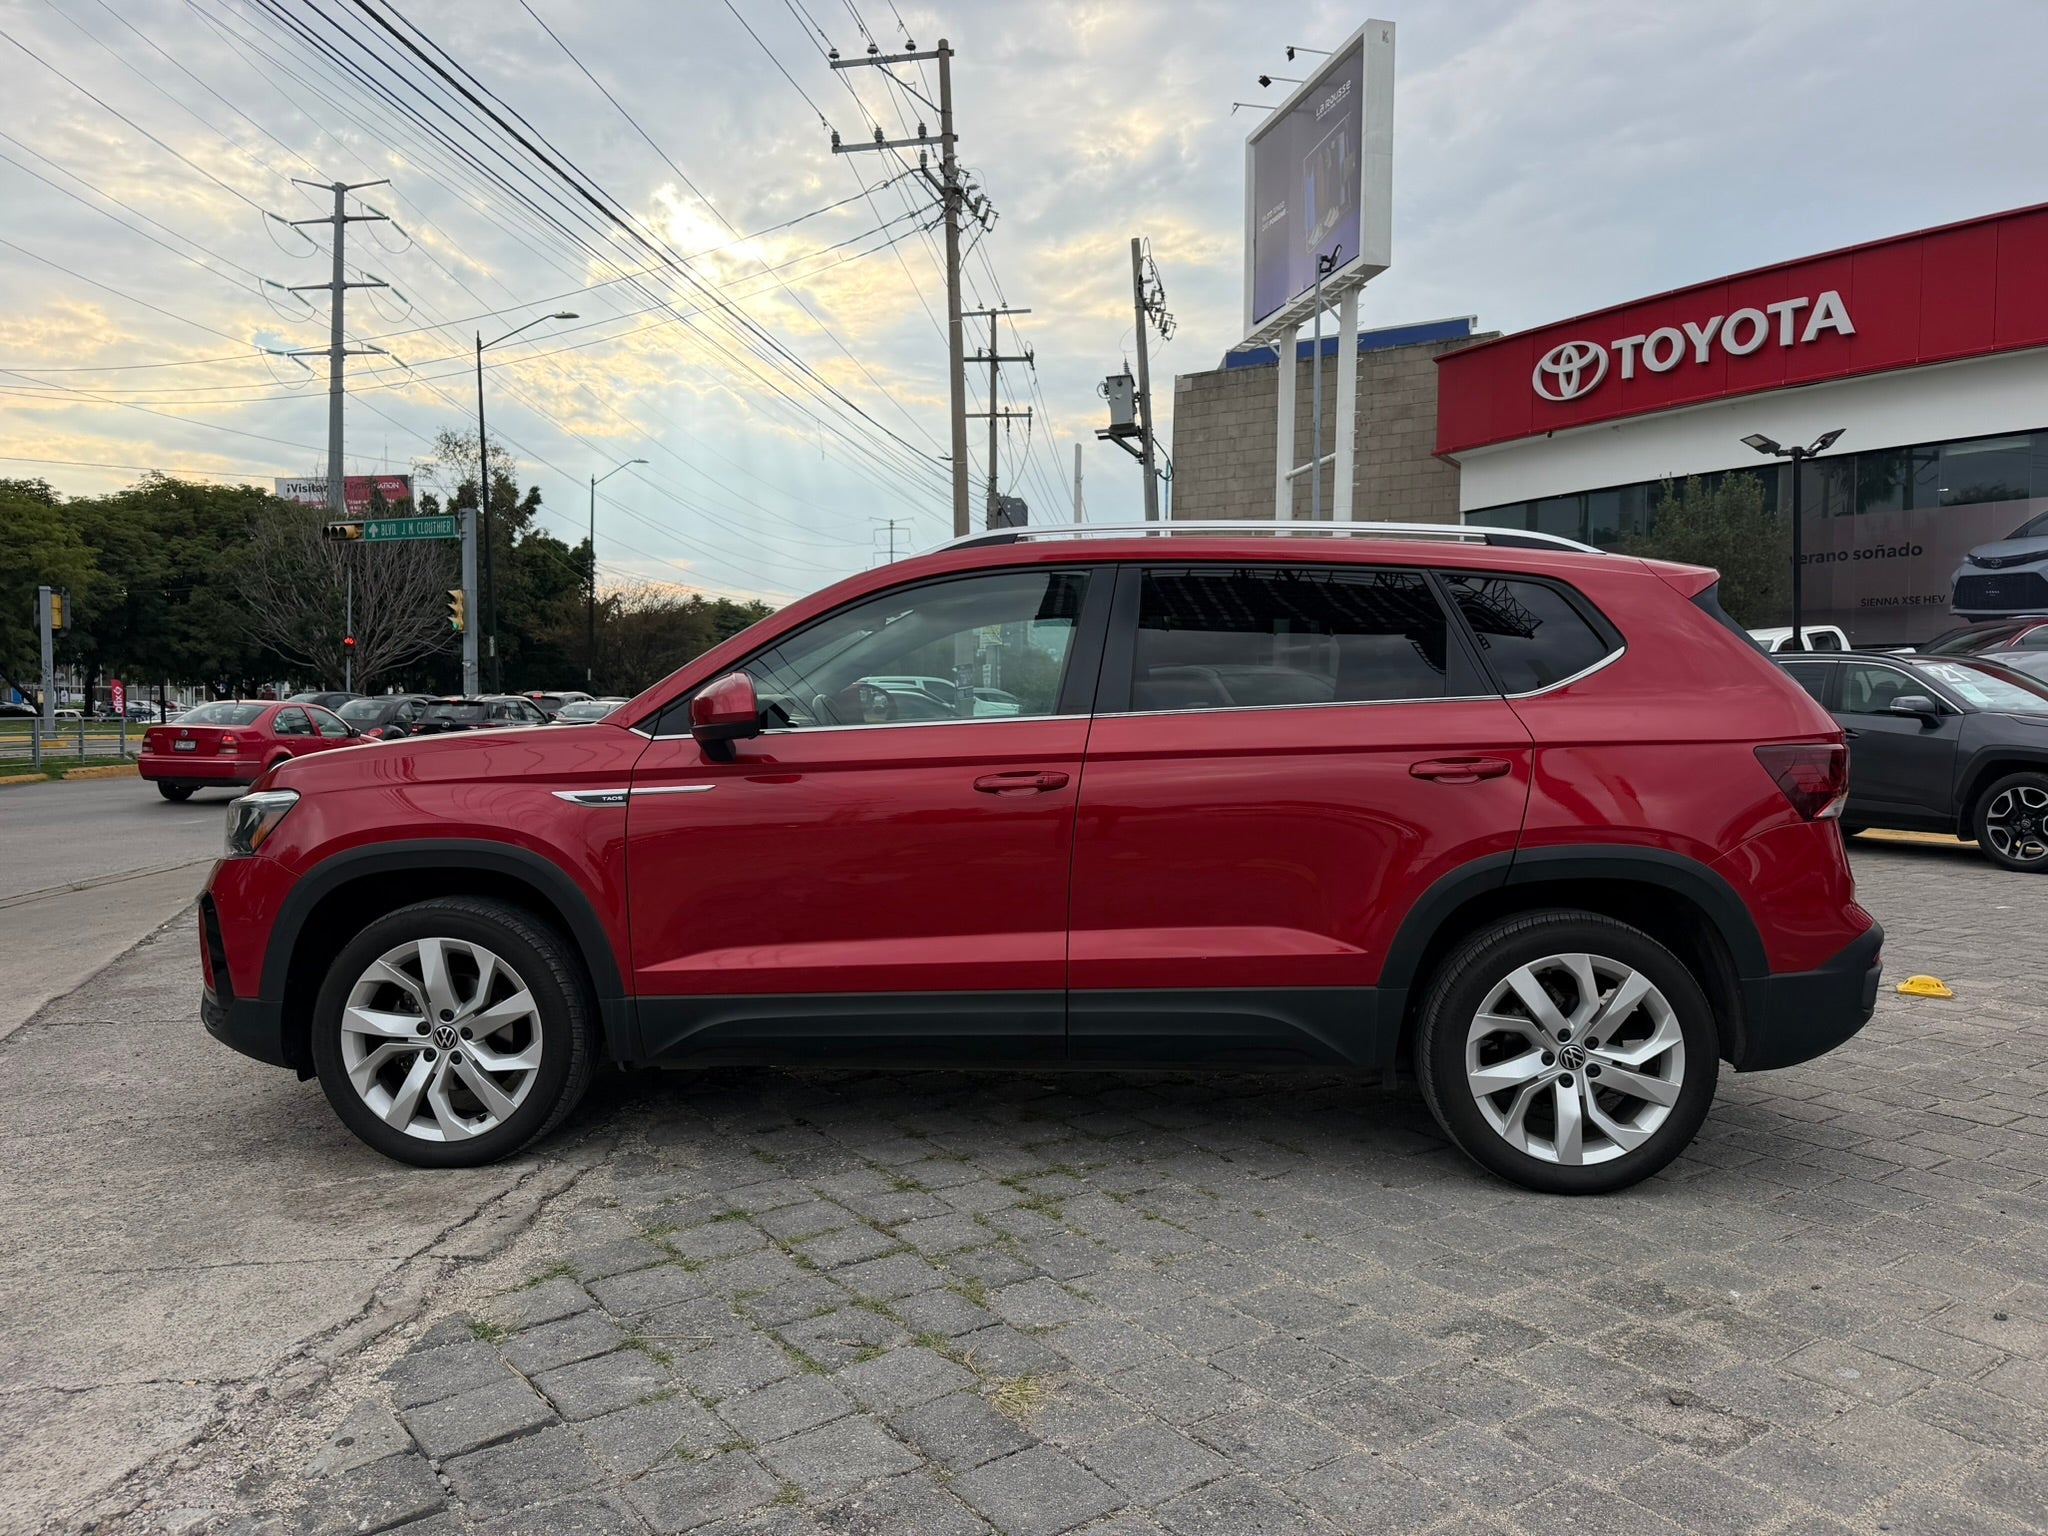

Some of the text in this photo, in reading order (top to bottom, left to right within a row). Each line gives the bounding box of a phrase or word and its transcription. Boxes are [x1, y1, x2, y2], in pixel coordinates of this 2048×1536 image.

[1611, 290, 1856, 379] TOYOTA
[416, 520, 451, 534] CLOUTHIER
[1852, 542, 1923, 560] soñado
[1860, 594, 1946, 608] SIENNA XSE HEV
[113, 695, 124, 713] ofix
